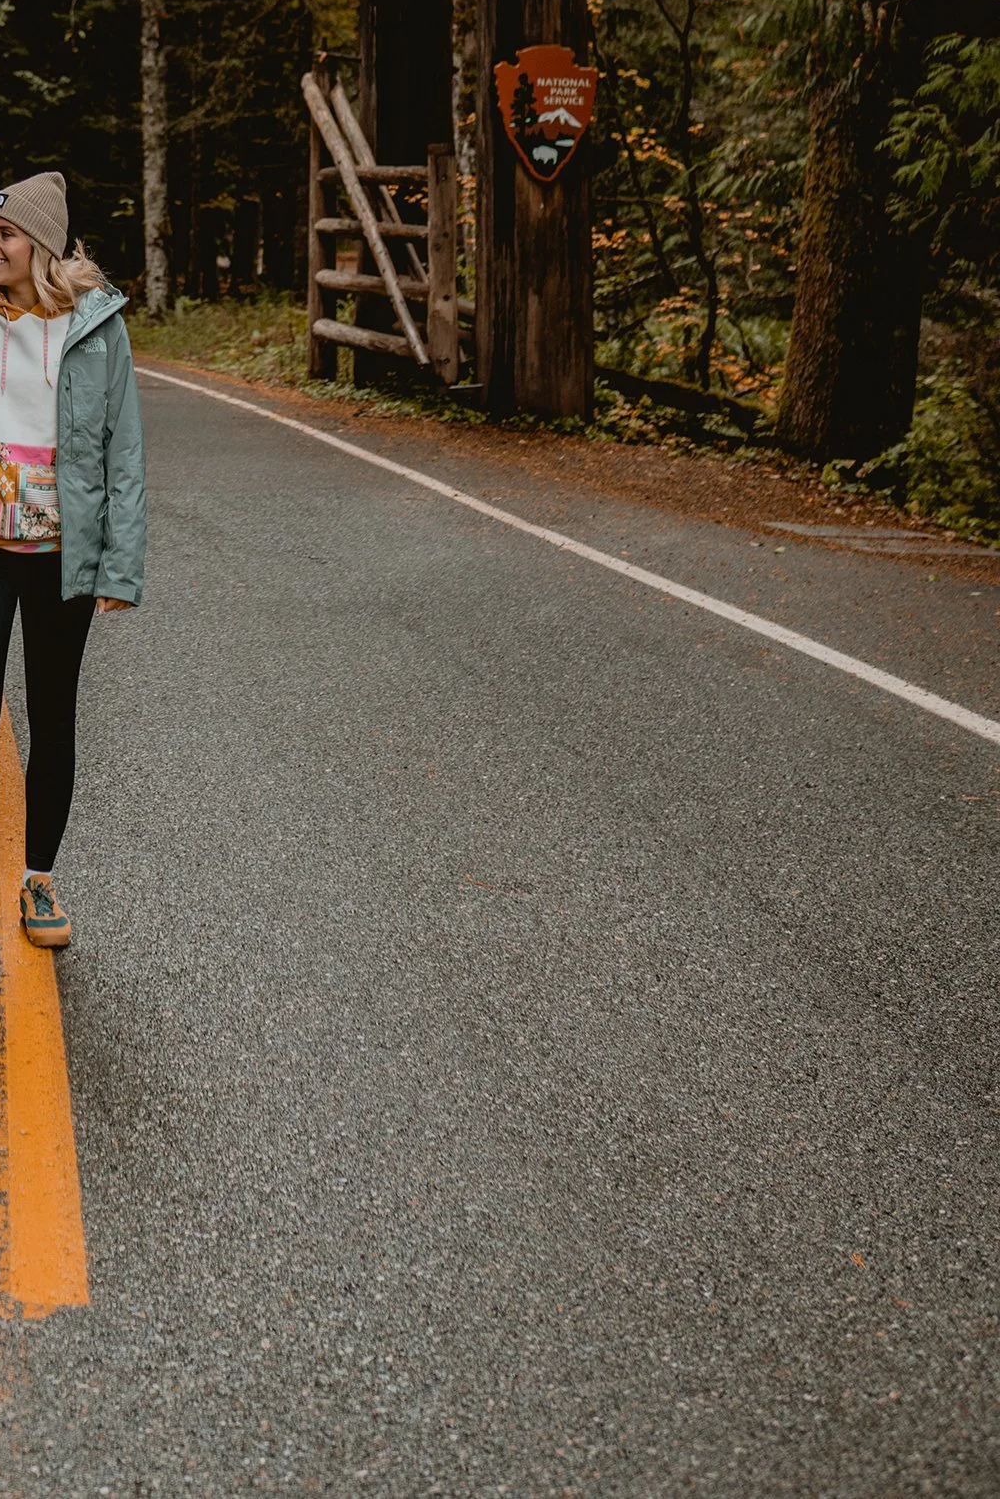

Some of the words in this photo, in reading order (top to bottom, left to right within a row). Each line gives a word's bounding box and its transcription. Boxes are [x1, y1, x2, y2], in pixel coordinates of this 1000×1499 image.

[536, 77, 591, 87] NATIONAL
[550, 87, 577, 96] PARK
[543, 96, 584, 105] SERVICE
